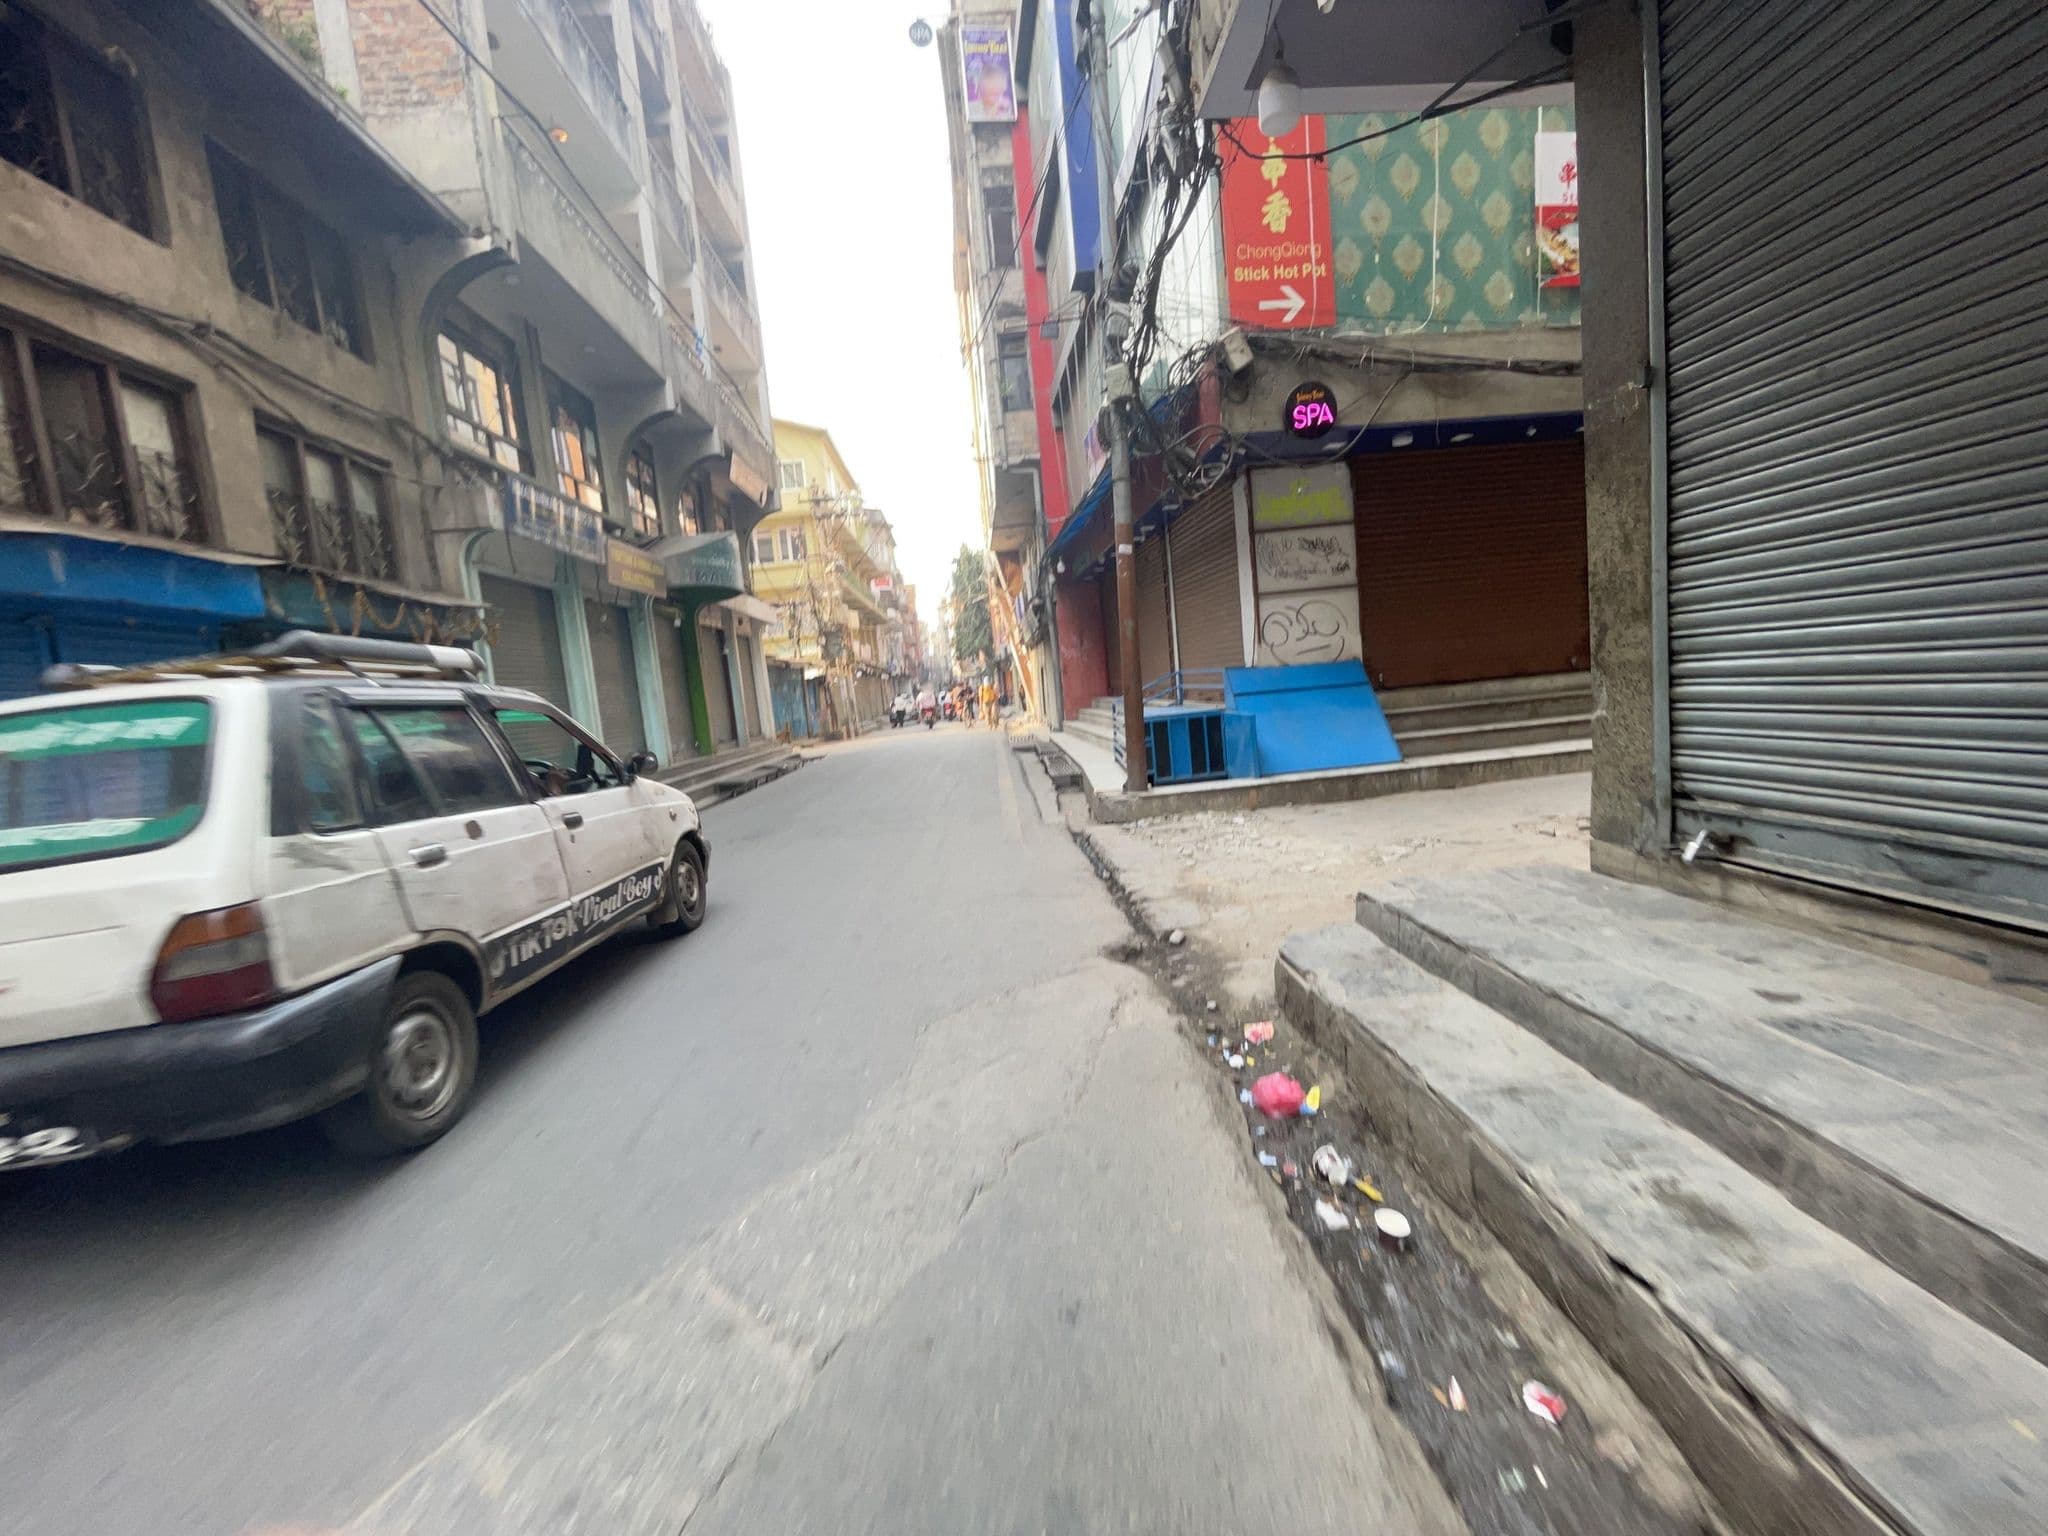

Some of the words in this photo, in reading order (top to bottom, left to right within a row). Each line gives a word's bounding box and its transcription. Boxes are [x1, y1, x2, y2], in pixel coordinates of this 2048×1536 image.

[1234, 264, 1270, 282] Stick
[1273, 263, 1299, 280] Hot
[1302, 261, 1327, 279] Pot
[1293, 402, 1334, 429] SPA
[579, 882, 624, 926] Viral
[623, 875, 653, 901] Boy
